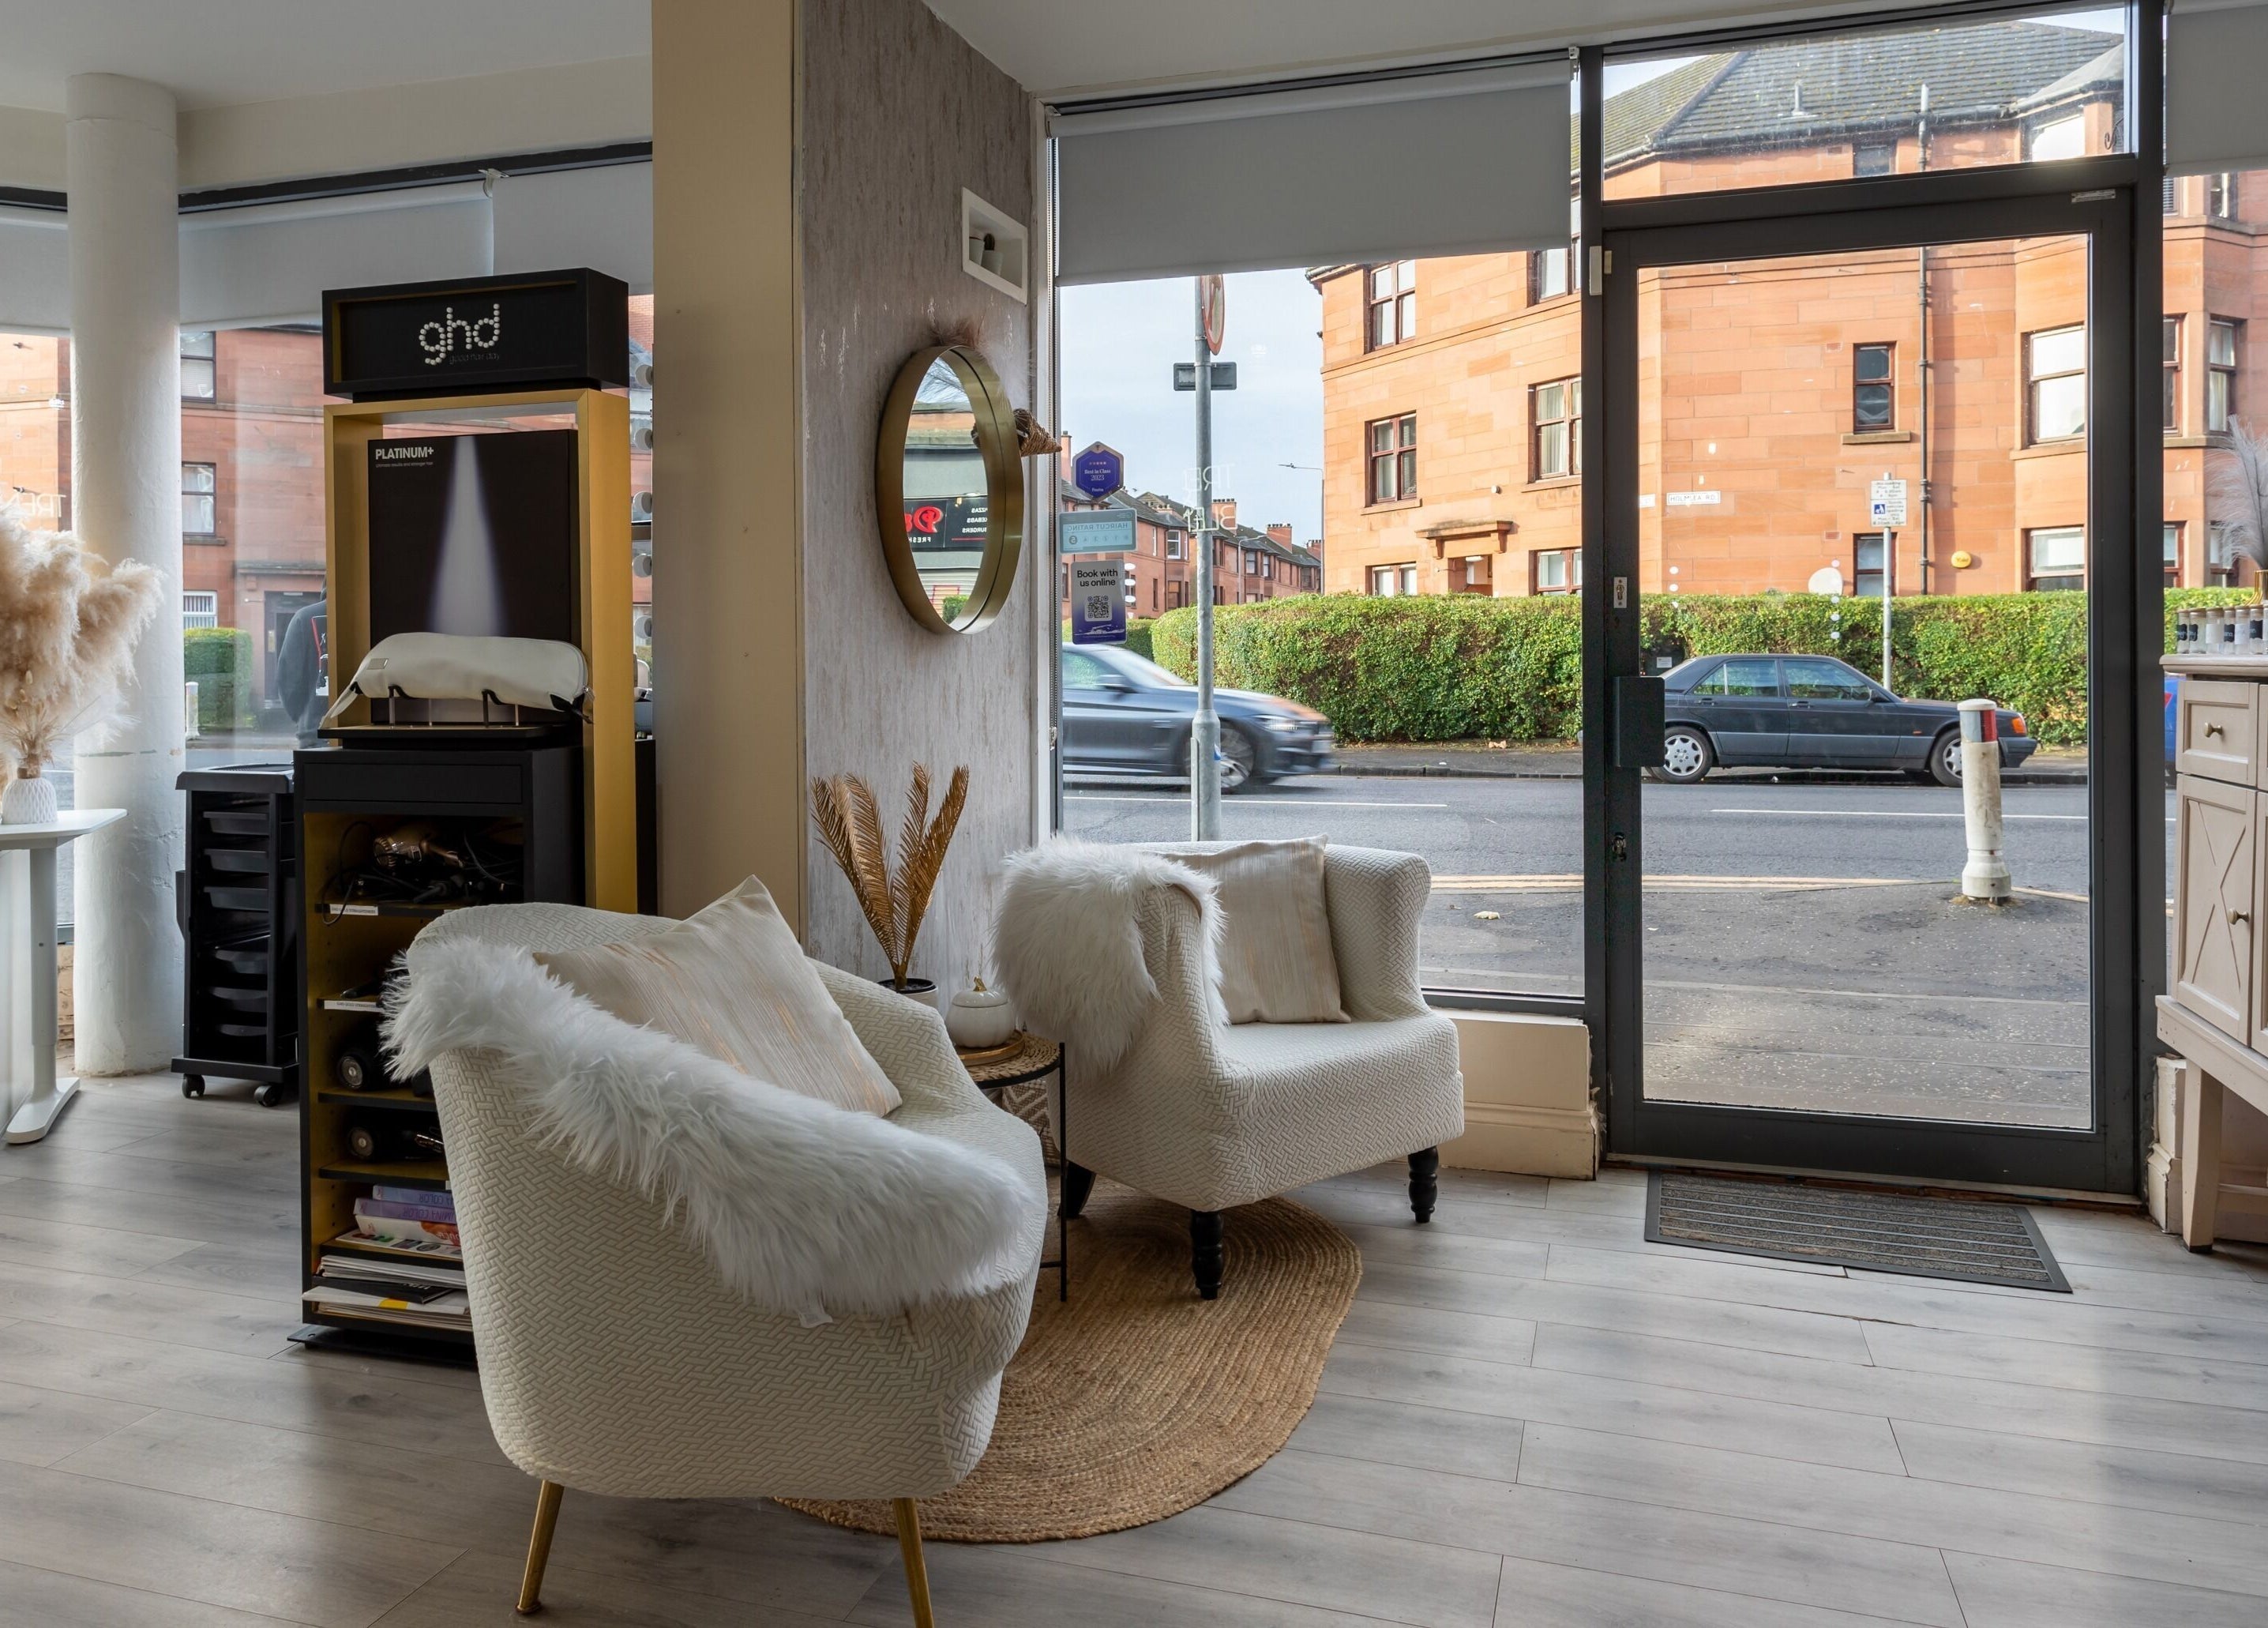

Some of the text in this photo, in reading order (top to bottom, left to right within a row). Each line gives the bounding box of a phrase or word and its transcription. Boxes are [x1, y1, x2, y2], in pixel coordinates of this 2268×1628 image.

[419, 303, 501, 366] ghd
[375, 446, 434, 460] PLATINUM+
[1077, 569, 1118, 578] Book with
[1091, 578, 1116, 587] online
